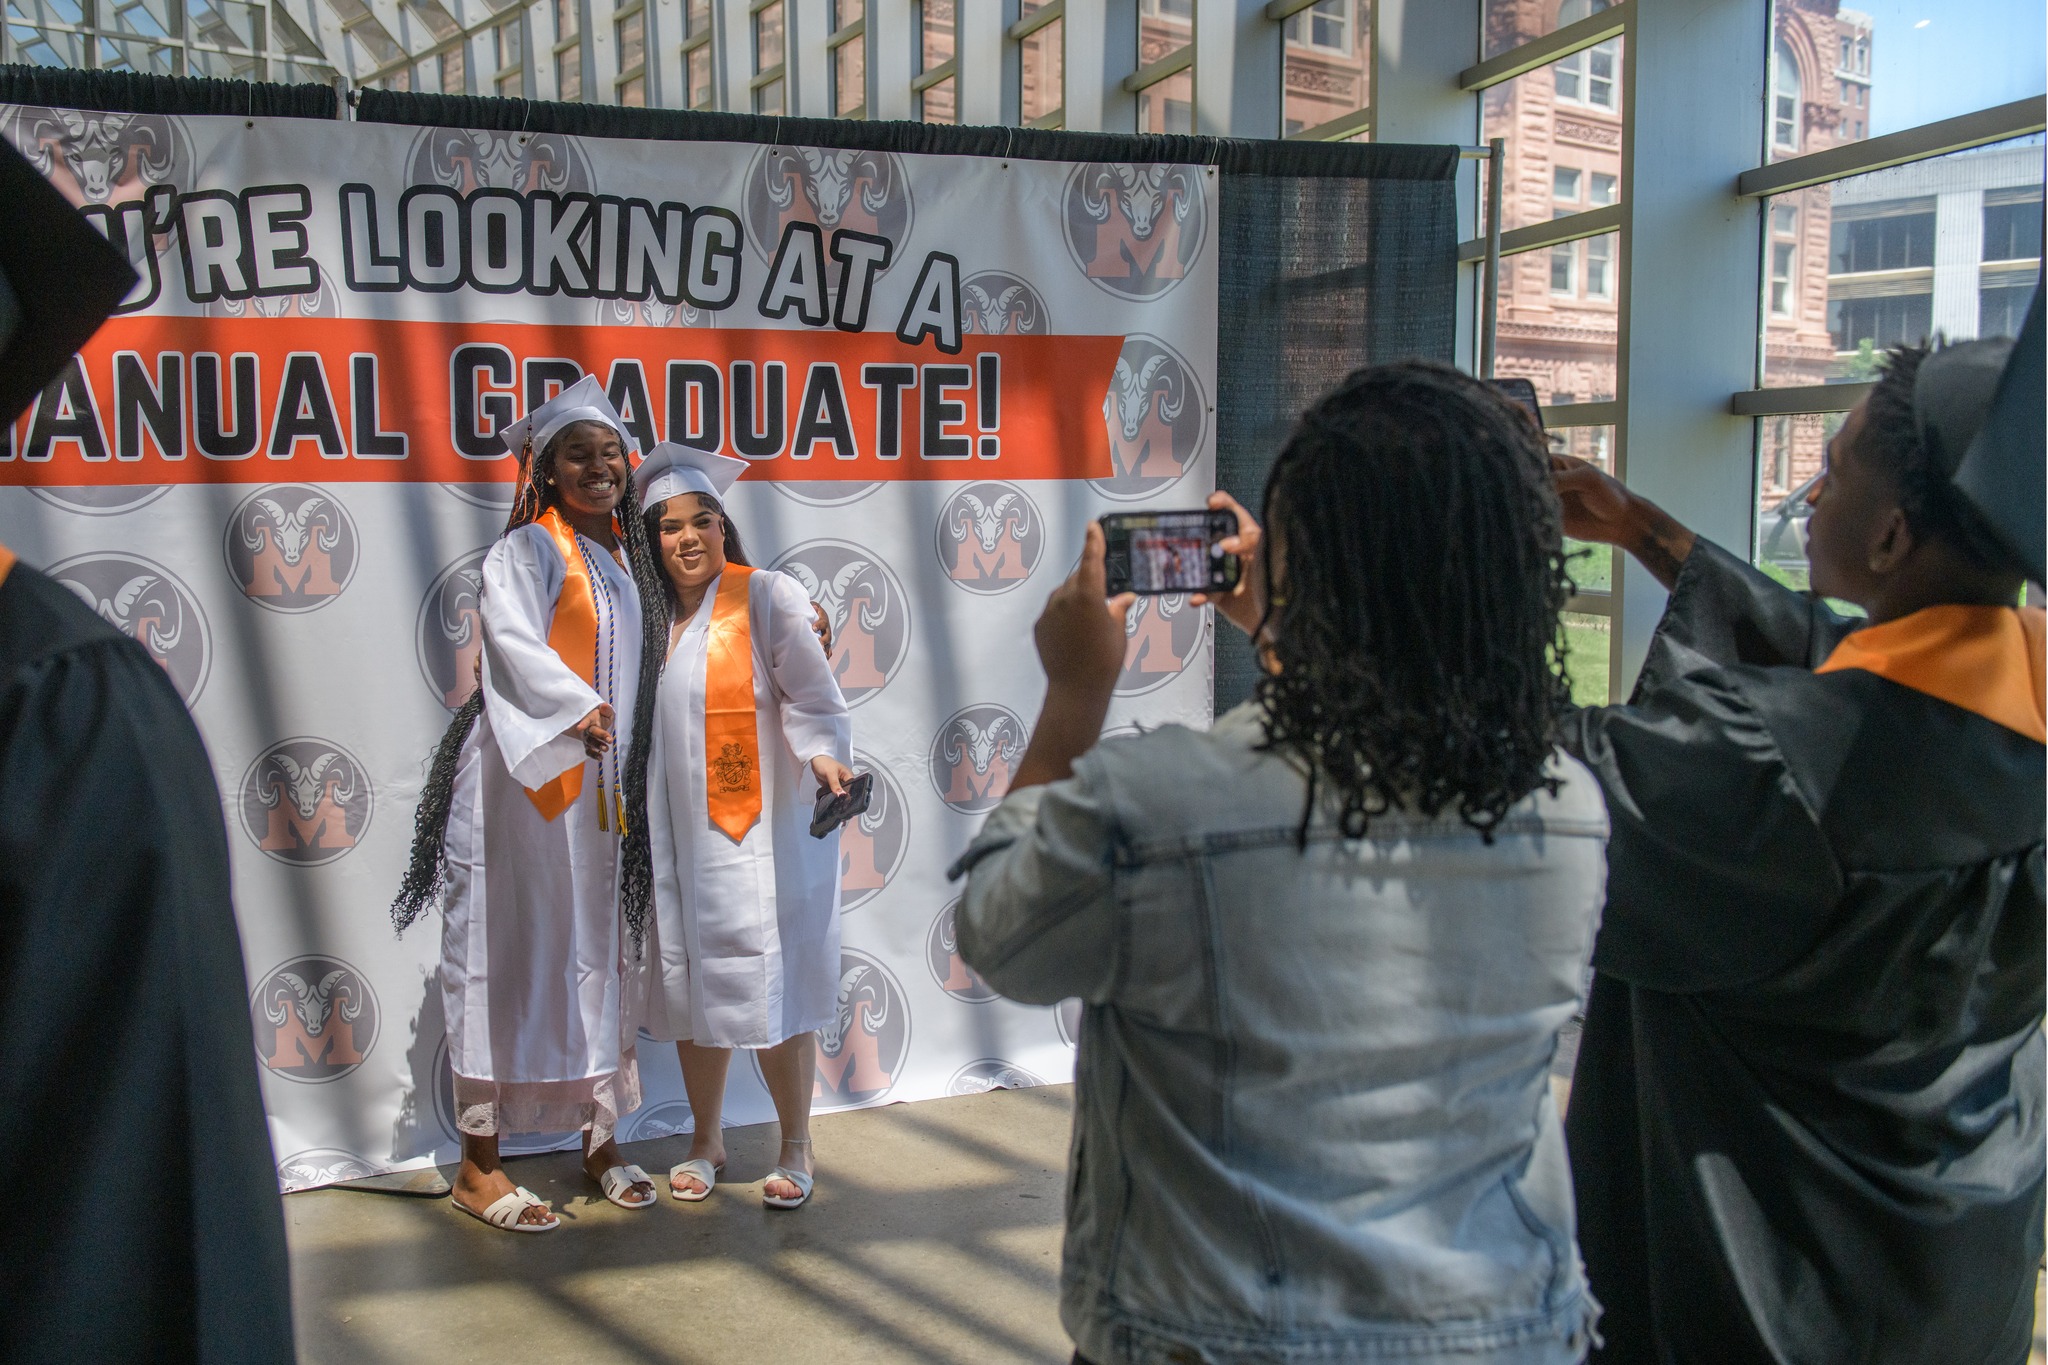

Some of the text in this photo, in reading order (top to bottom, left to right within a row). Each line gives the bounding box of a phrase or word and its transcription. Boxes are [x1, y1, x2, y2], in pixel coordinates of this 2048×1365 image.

[78, 183, 321, 316] U'RE
[339, 182, 744, 312] LOOKING
[758, 221, 893, 333] AT
[896, 251, 963, 355] A
[0, 350, 409, 463] ANUAL
